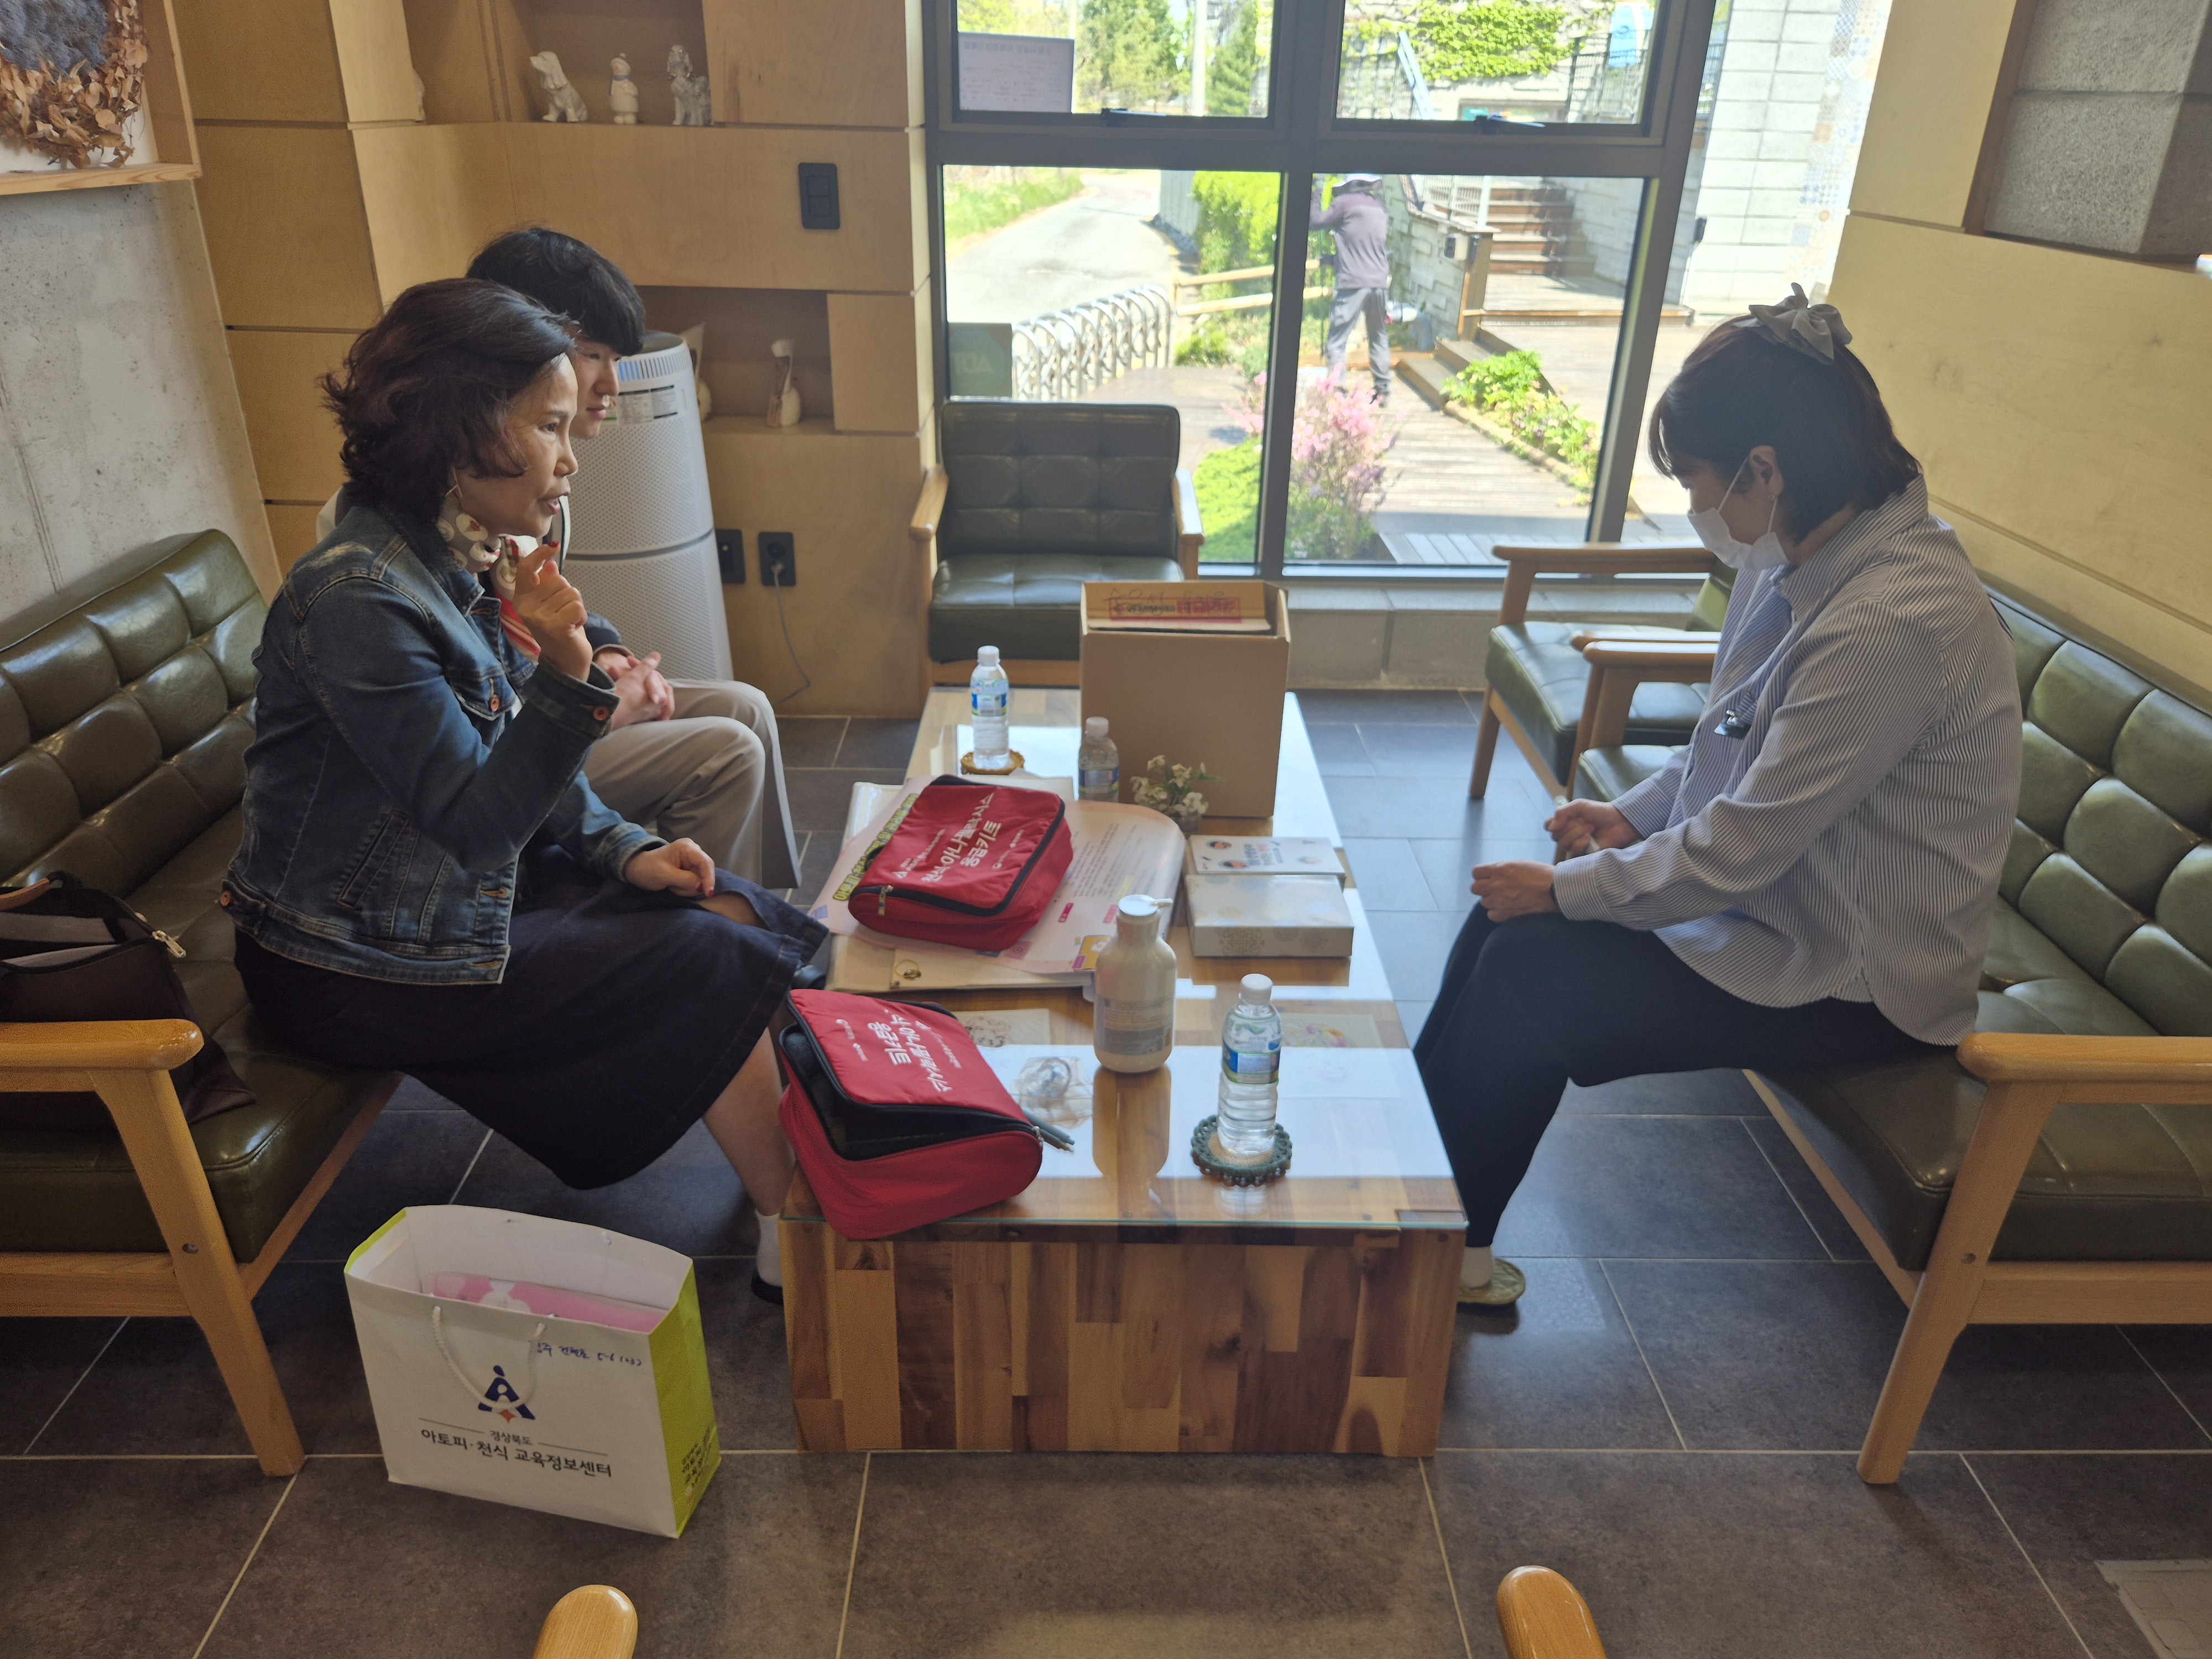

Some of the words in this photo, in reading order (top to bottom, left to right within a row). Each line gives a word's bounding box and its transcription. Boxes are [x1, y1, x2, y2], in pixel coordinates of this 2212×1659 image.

[960, 820, 1002, 867] 응급키트
[867, 1021, 912, 1066] 응급키트
[884, 1008, 953, 1093] 식·아나필락시스
[490, 1430, 533, 1446] 경상북도
[515, 1448, 612, 1478] 교육정보센터
